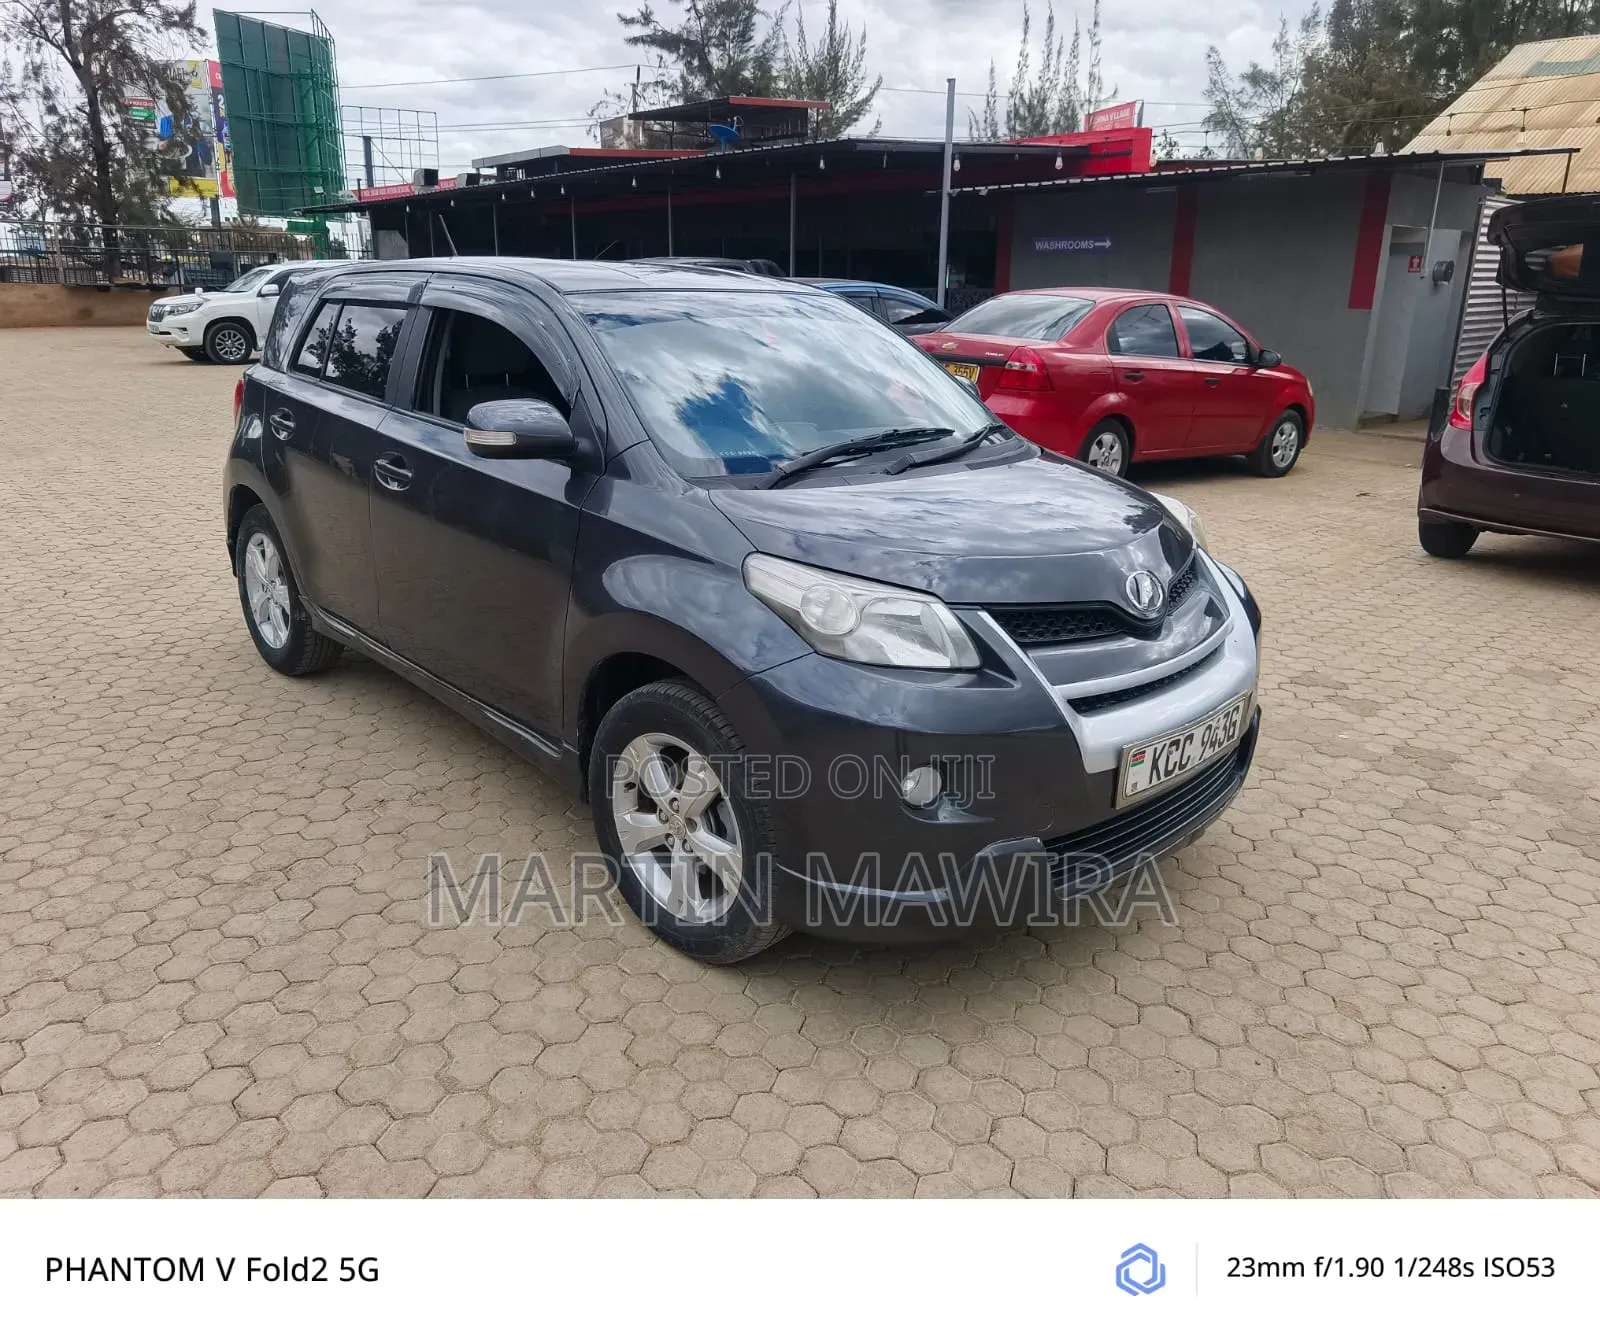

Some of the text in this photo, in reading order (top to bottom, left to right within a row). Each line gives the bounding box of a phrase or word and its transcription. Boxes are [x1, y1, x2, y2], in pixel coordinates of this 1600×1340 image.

[1035, 240, 1094, 250] WASHROOMS
[1148, 705, 1241, 785] KCC 943G
